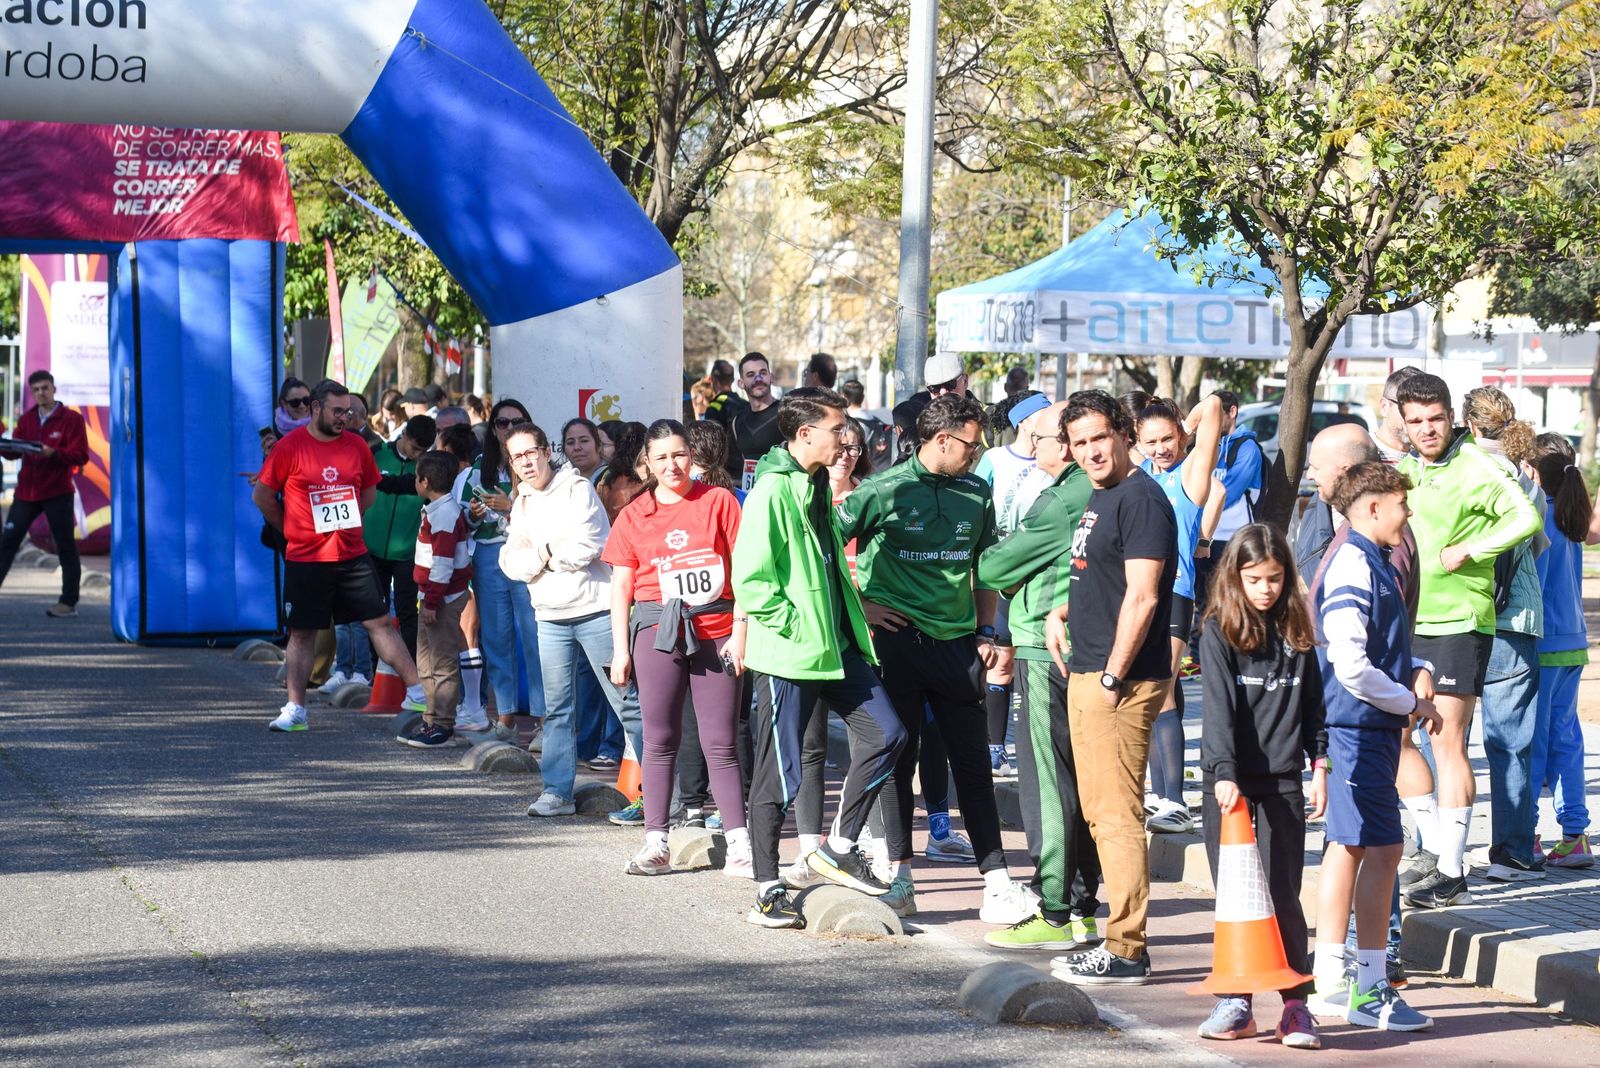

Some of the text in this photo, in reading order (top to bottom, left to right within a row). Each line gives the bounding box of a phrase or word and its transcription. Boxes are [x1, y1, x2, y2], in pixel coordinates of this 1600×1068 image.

[113, 124, 145, 138] NO
[113, 137, 280, 160] DE CORRER MÁS,
[113, 159, 242, 177] SE TRATA DE
[113, 179, 198, 196] CORRER
[113, 199, 184, 216] MEJOR
[322, 503, 350, 523] 213
[899, 550, 939, 561] ATLETISMO
[674, 570, 712, 596] 108
